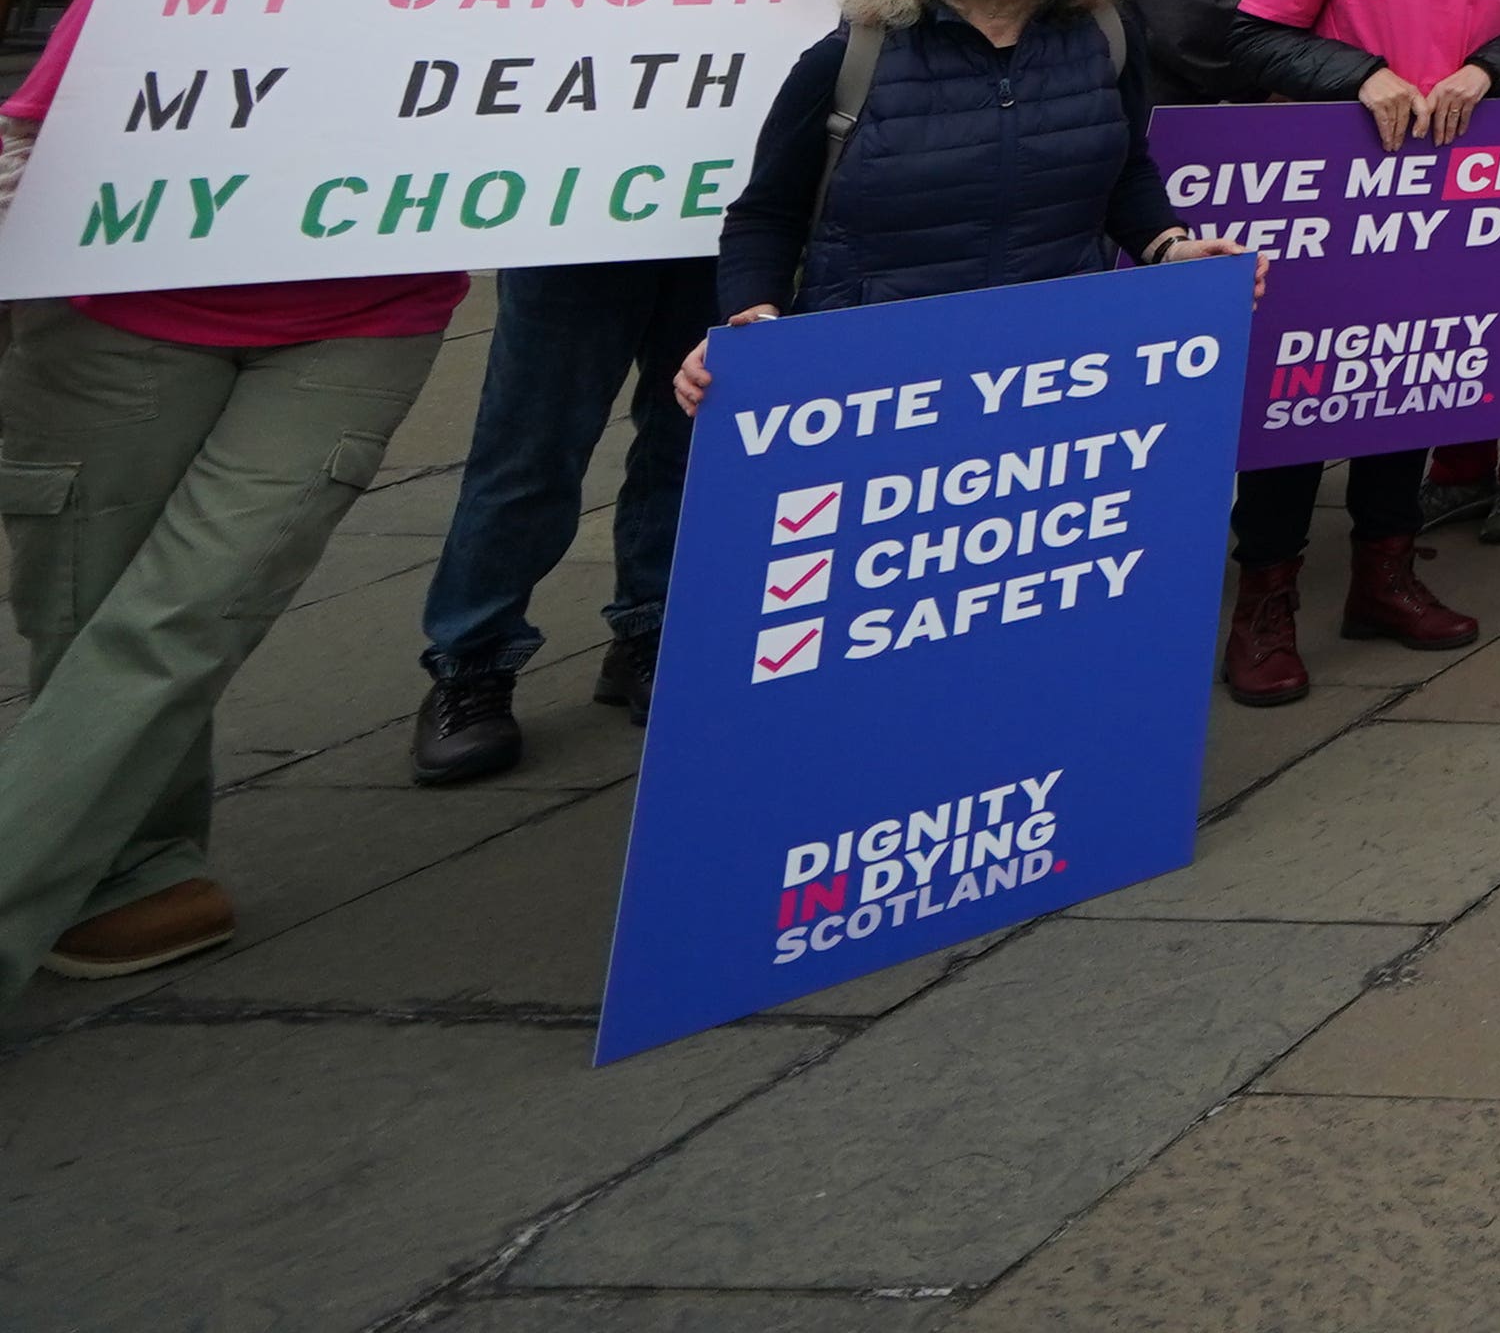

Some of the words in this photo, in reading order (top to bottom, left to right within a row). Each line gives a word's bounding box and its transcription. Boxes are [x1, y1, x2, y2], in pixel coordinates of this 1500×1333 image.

[125, 64, 290, 133] MY
[398, 50, 746, 121] DEATH
[79, 171, 250, 247] MY
[300, 156, 735, 241] CHOICE
[1165, 159, 1327, 208] GIVE
[1344, 154, 1438, 200] ME
[1350, 208, 1450, 256] MY
[1267, 361, 1325, 400] IN
[1331, 347, 1489, 394] DYING
[1275, 312, 1499, 367] DIGNITY
[733, 380, 943, 459] VOTE
[970, 352, 1112, 415] YES
[1134, 333, 1221, 387] TO
[1262, 380, 1495, 431] SCOTLAND.
[860, 421, 1167, 526] DIGNITY
[853, 489, 1131, 591] CHOICE
[842, 548, 1145, 663] SAFETY
[775, 873, 849, 931] IN
[859, 809, 1058, 907] DYING
[781, 768, 1065, 890] DIGNITY
[772, 848, 1068, 966] SCOTLAND.
